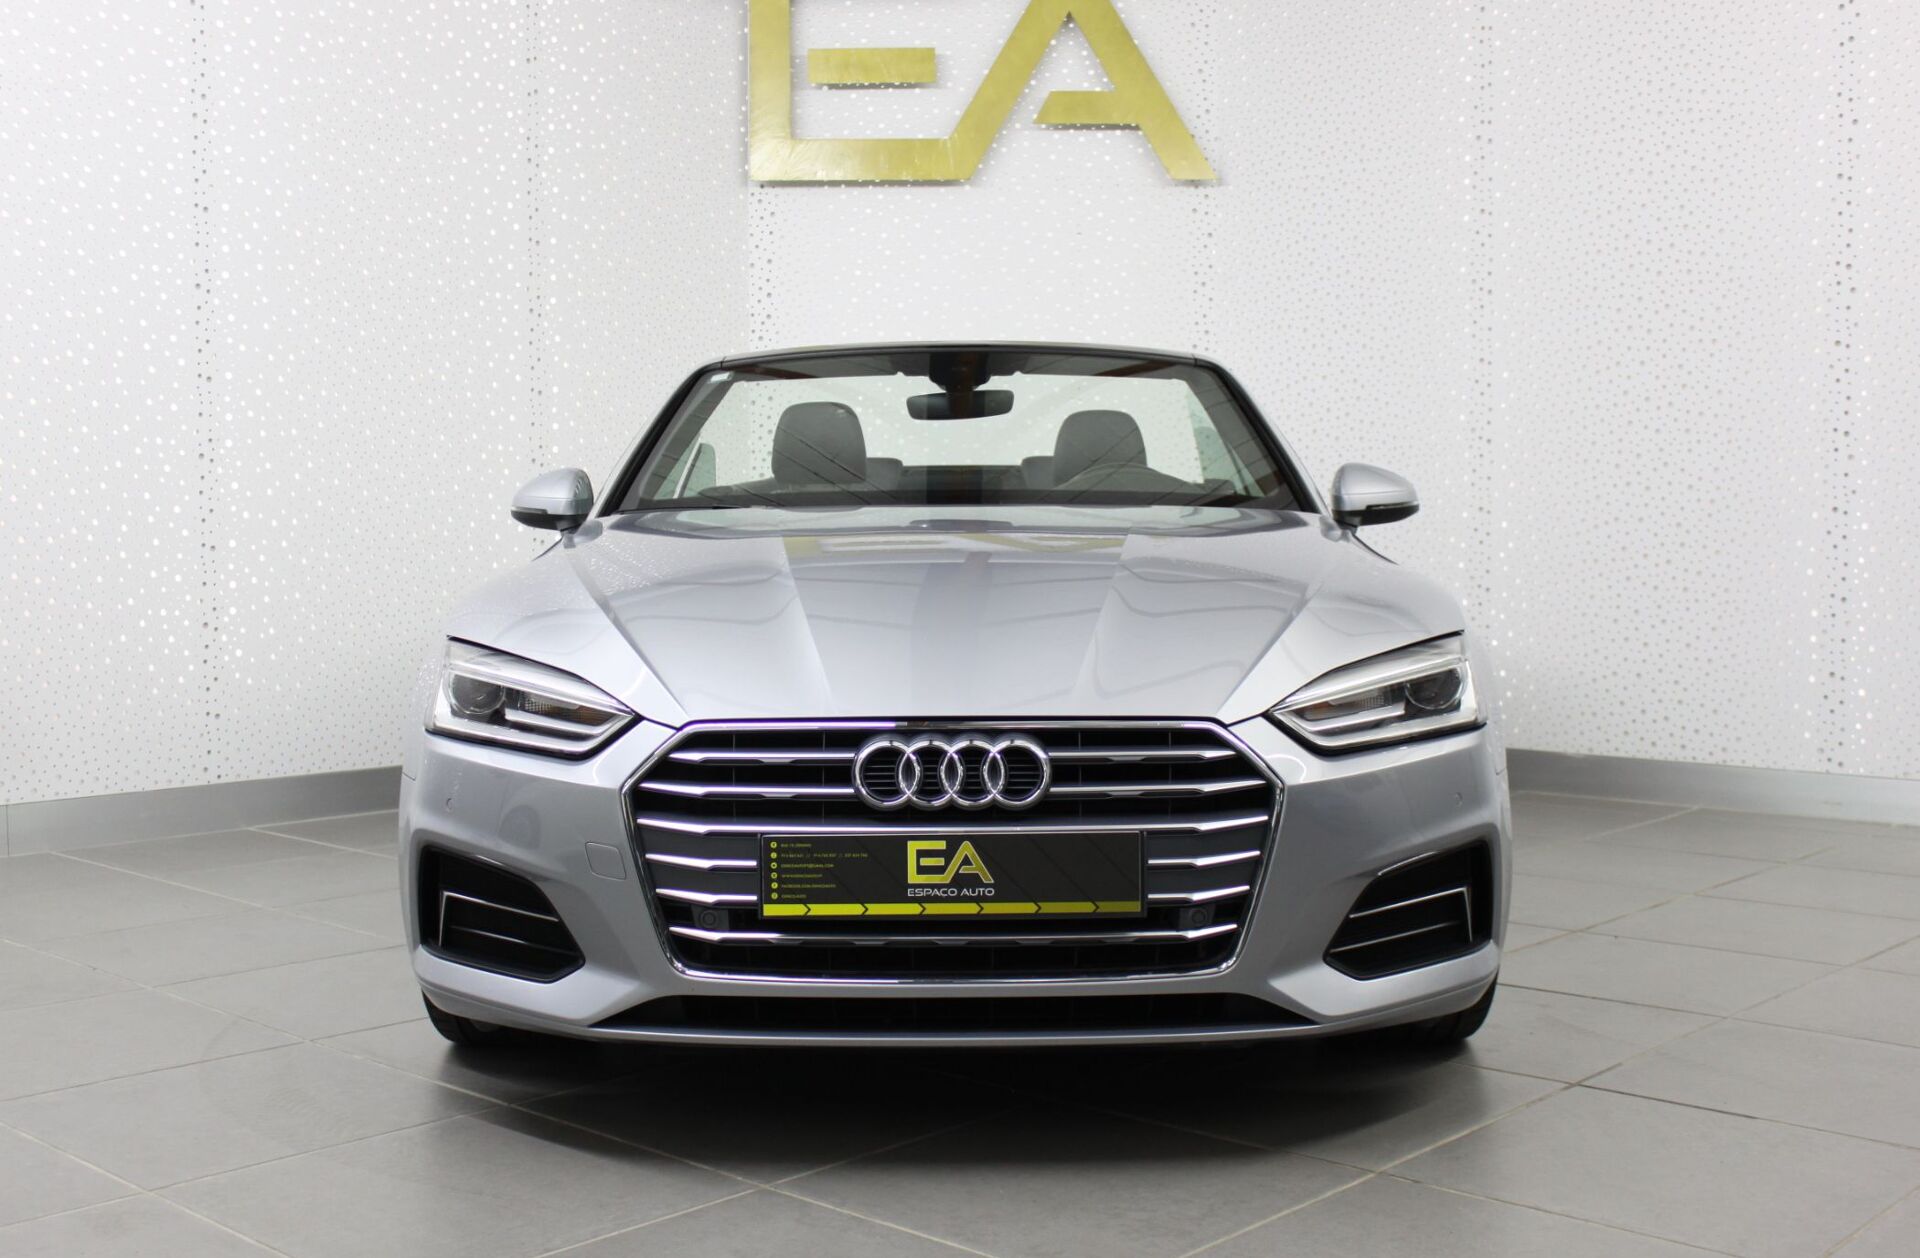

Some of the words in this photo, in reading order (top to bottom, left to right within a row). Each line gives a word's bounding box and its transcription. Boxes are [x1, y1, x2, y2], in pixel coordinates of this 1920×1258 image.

[748, 0, 1217, 181] EA
[907, 840, 994, 883] EA
[960, 888, 995, 897] AUTO
